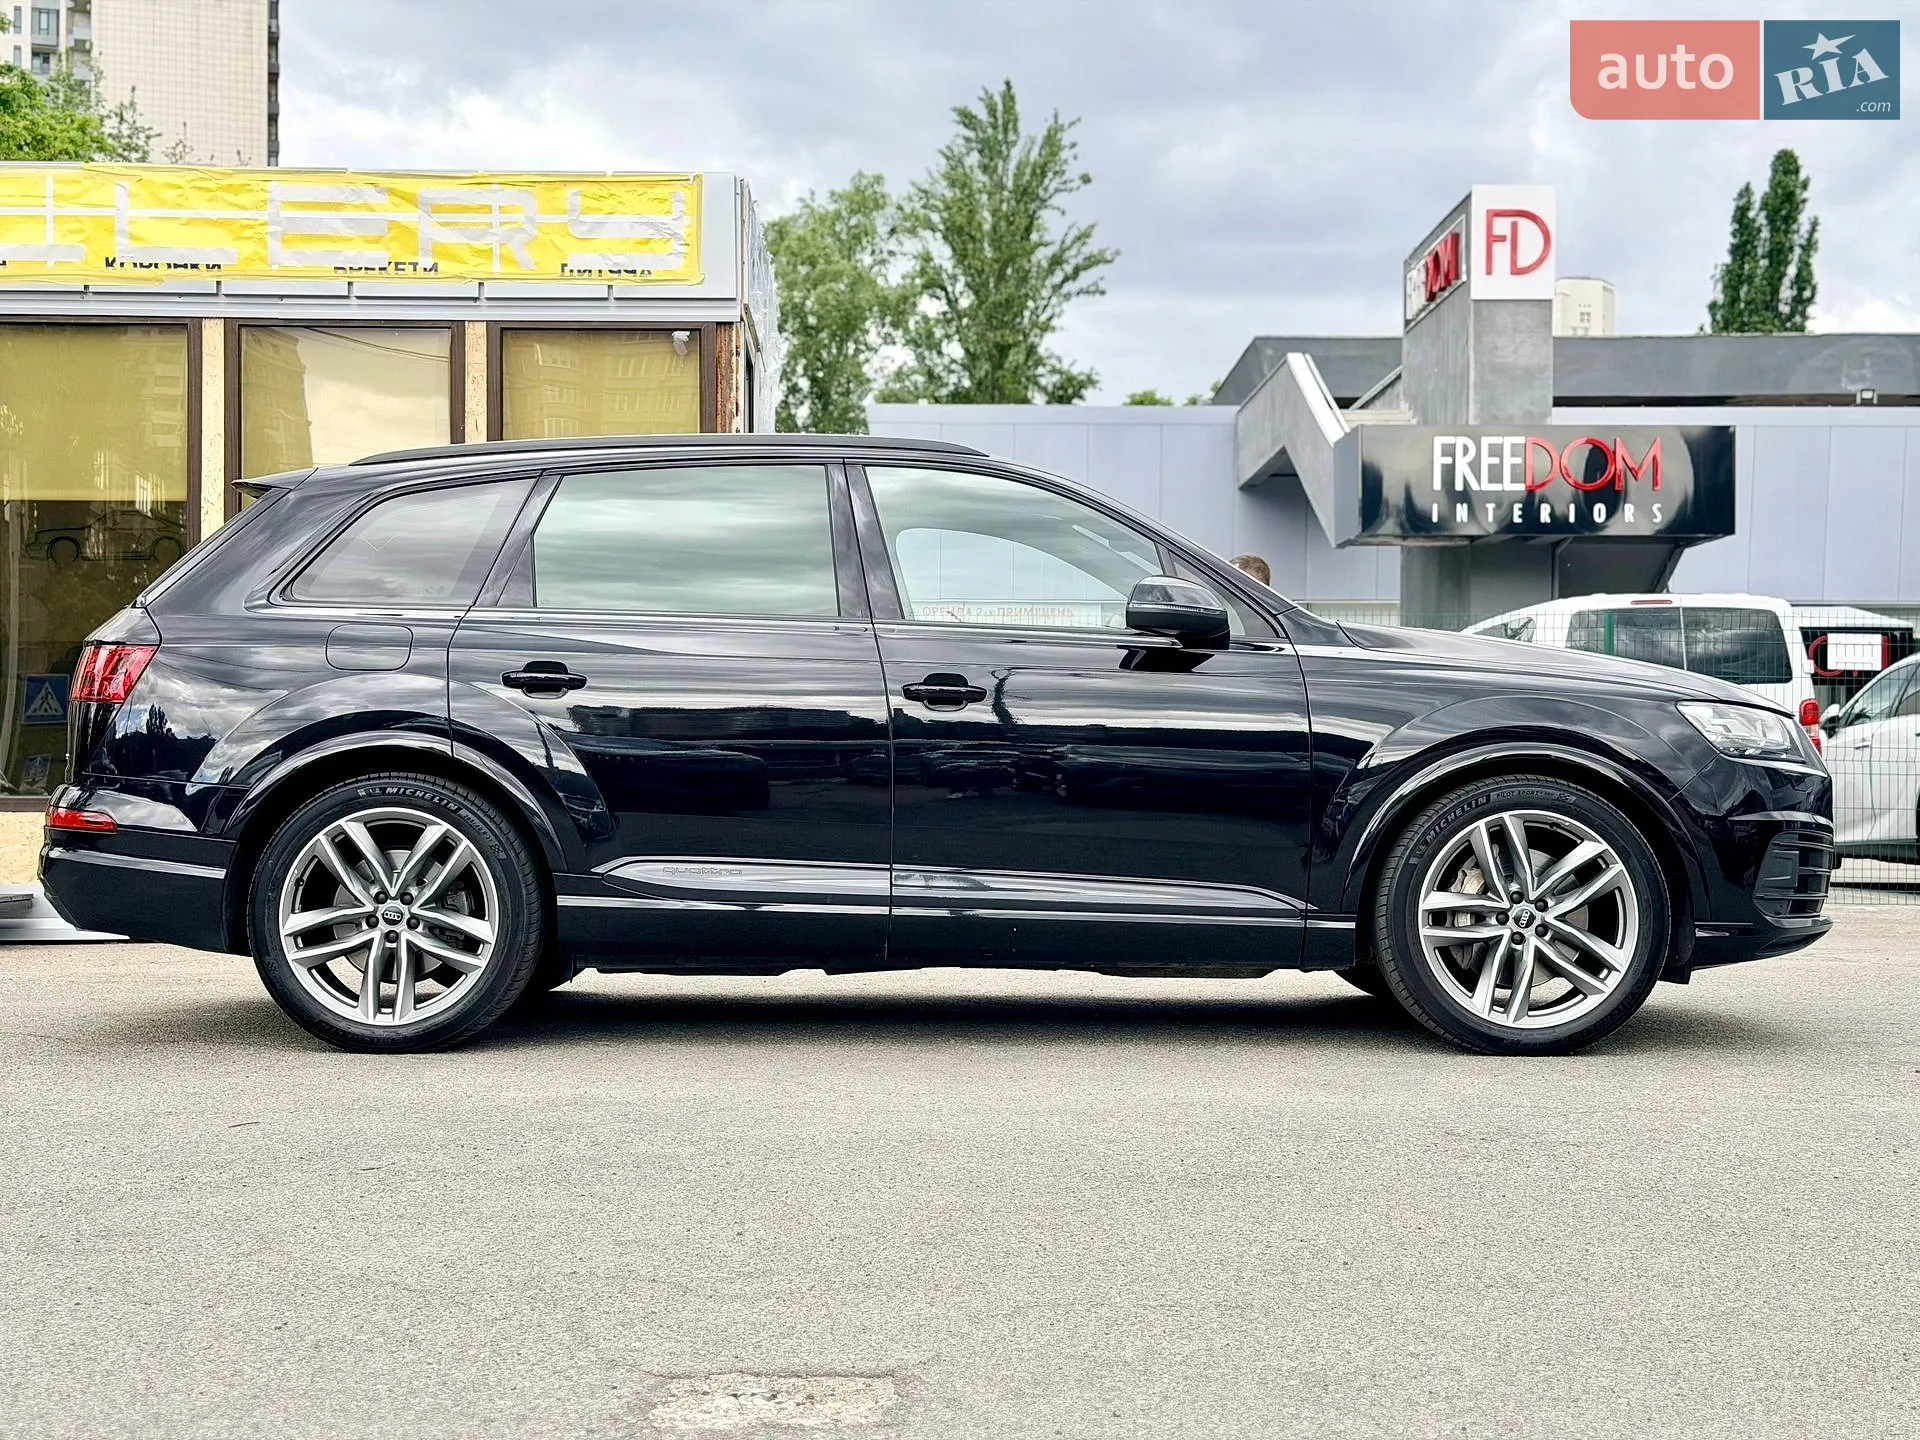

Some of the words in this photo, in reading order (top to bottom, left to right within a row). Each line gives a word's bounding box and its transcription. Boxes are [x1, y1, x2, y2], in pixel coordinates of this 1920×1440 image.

[1485, 208, 1553, 276] FD
[1432, 435, 1662, 492] FREEDOM
[1431, 502, 1663, 524] INTERIORS
[385, 786, 459, 812] MICHELIN
[1425, 795, 1487, 845] MICHELIN
[662, 866, 743, 876] quattro
